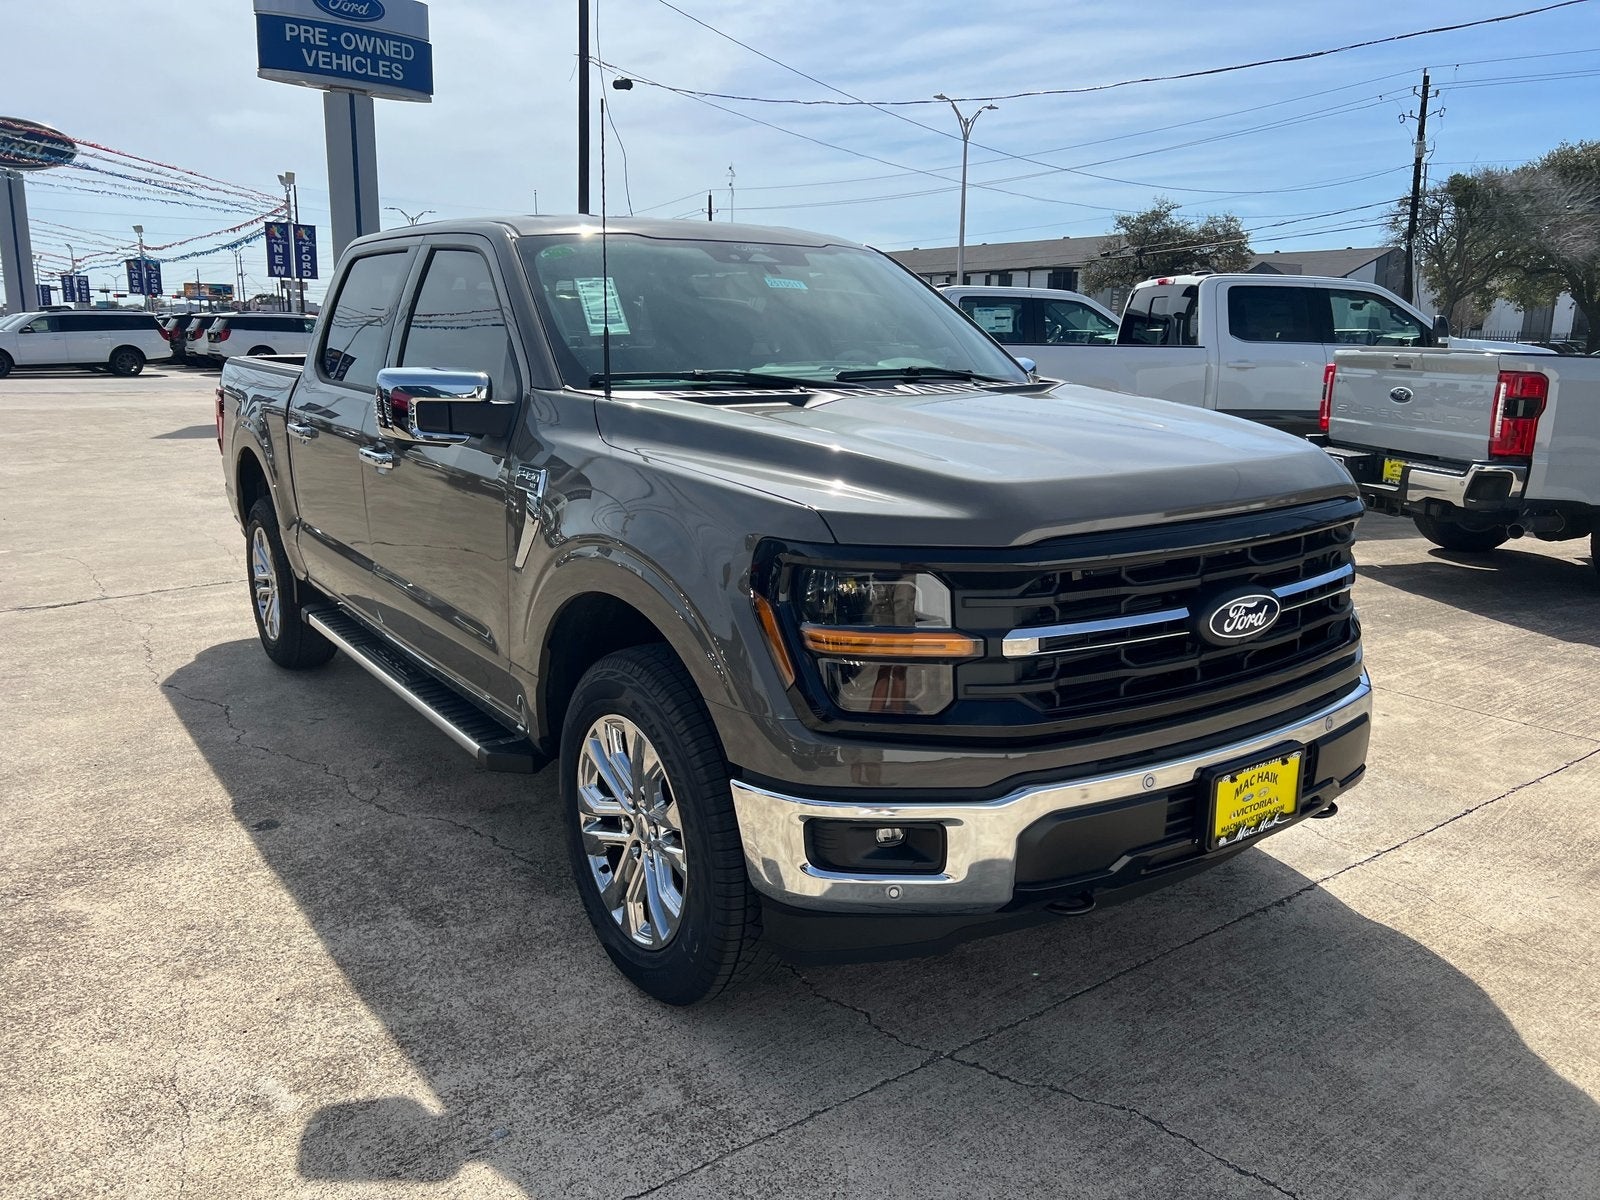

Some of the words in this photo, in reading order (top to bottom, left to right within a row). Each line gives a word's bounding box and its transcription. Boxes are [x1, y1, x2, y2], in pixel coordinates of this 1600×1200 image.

[302, 48, 404, 81] VEHICLES
[273, 244, 286, 276] NEW
[301, 246, 312, 277] FORD
[131, 272, 141, 293] NEW
[1224, 601, 1268, 633] Ford
[1234, 774, 1257, 800] MAC
[1257, 771, 1279, 785] HAIK
[1235, 798, 1273, 818] VICTORIA
